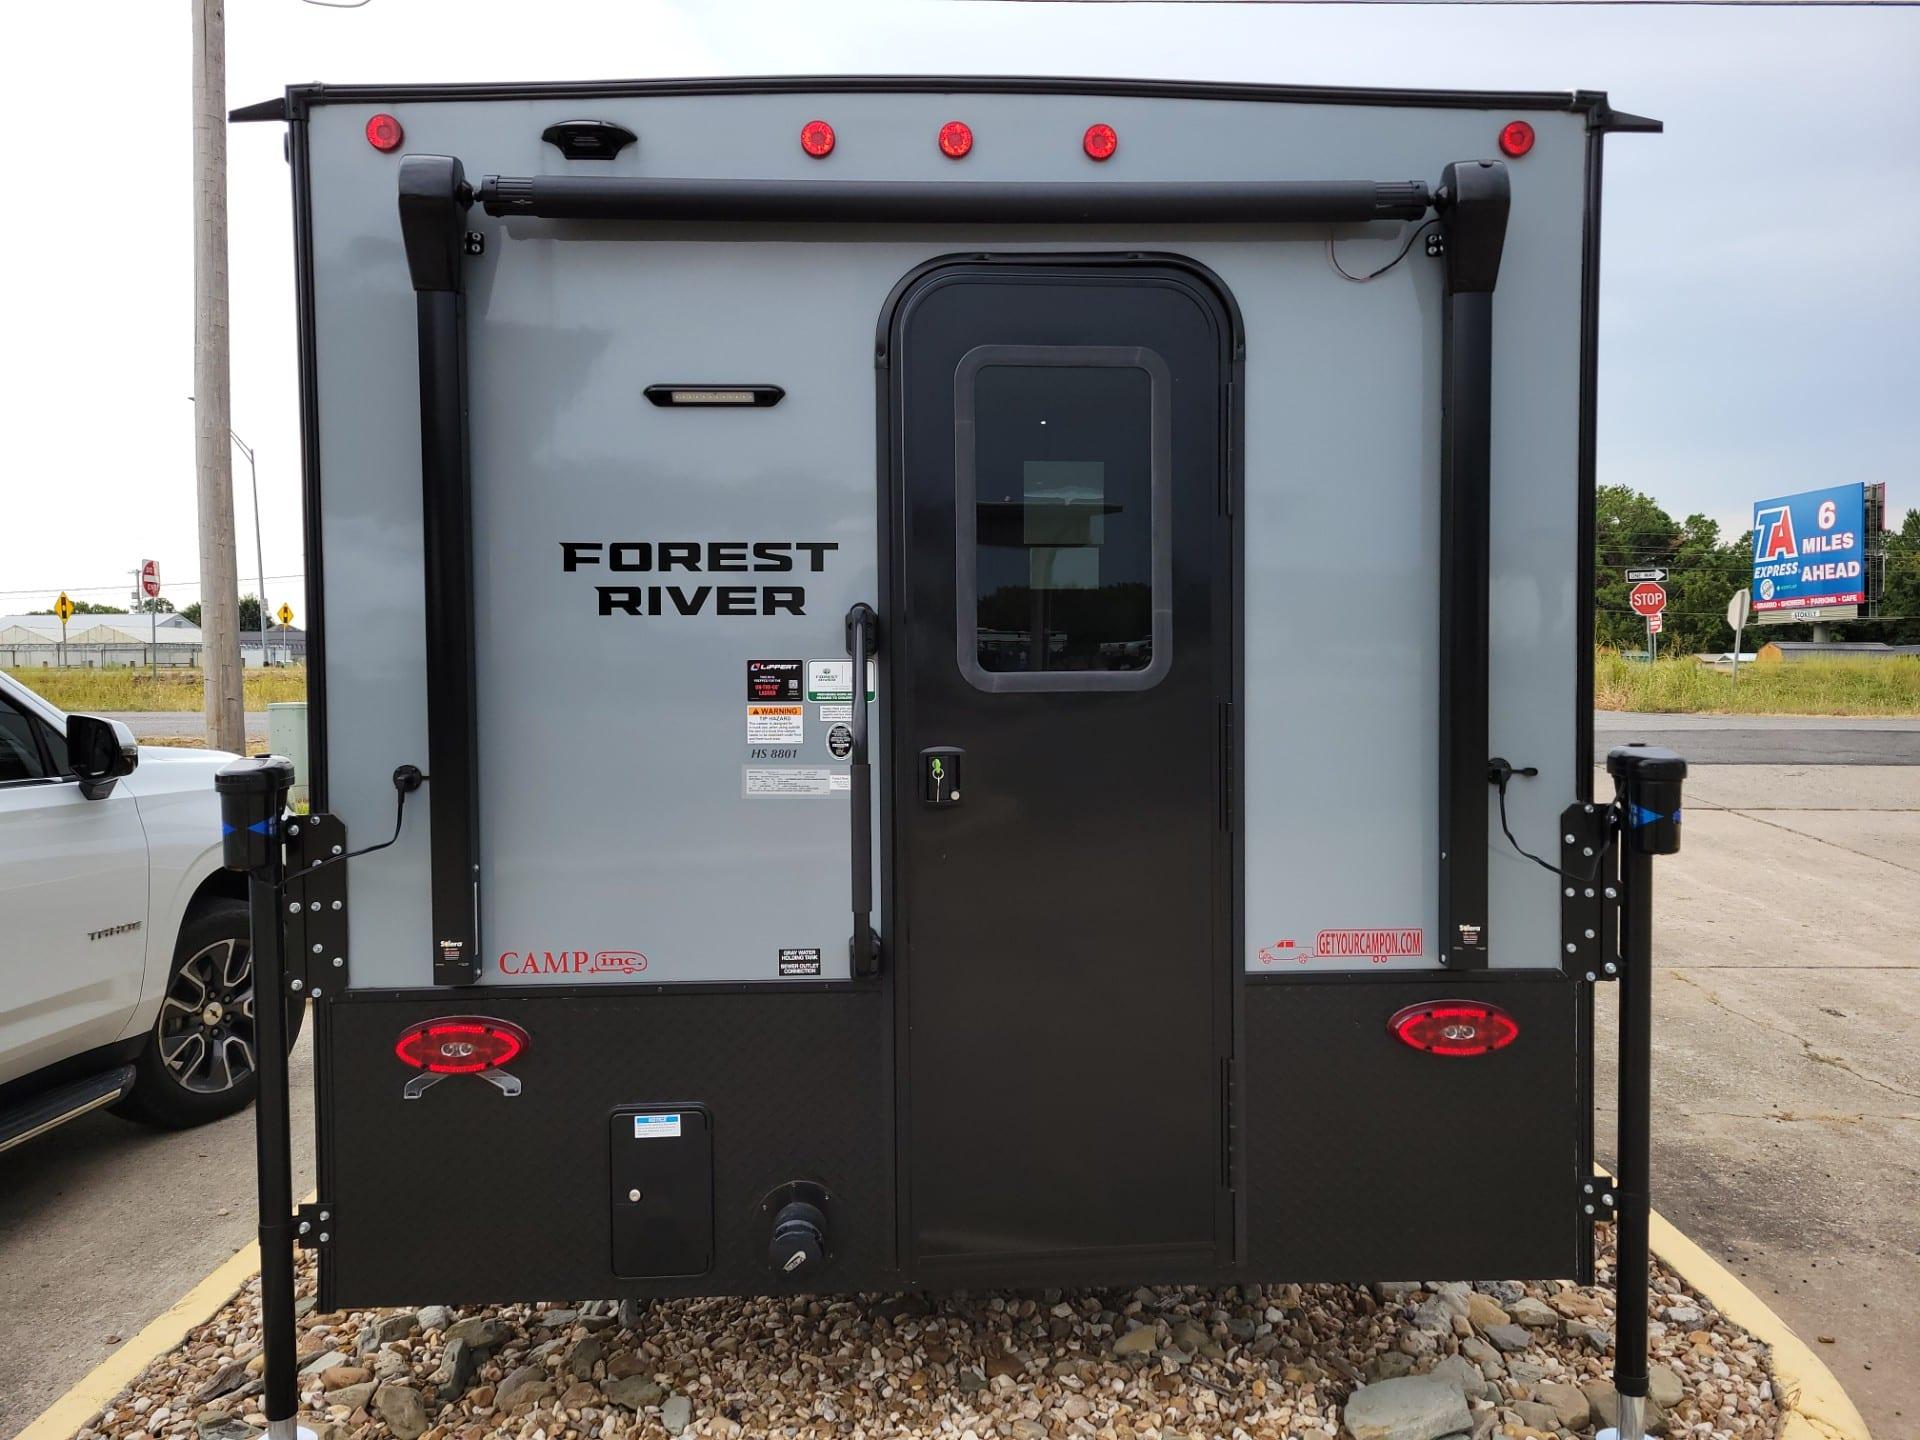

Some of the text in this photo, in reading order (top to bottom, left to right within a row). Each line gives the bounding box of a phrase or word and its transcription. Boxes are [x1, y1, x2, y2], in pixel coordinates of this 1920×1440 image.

[1818, 501, 1836, 530] 6
[1755, 506, 1799, 563] TA
[1802, 532, 1854, 554] MILES
[559, 542, 839, 572] FOREST
[1754, 562, 1799, 579] EXPRESS
[1801, 561, 1860, 582] AHEAD
[594, 586, 807, 616] RIVER
[1634, 593, 1663, 606] STOP
[1811, 596, 1836, 605] PARKING
[752, 749, 797, 759] HS 8801
[88, 920, 142, 940] TAHOE
[1320, 932, 1420, 954] GETYOURCAMPON.COM
[499, 951, 642, 974] CAMP inc.
